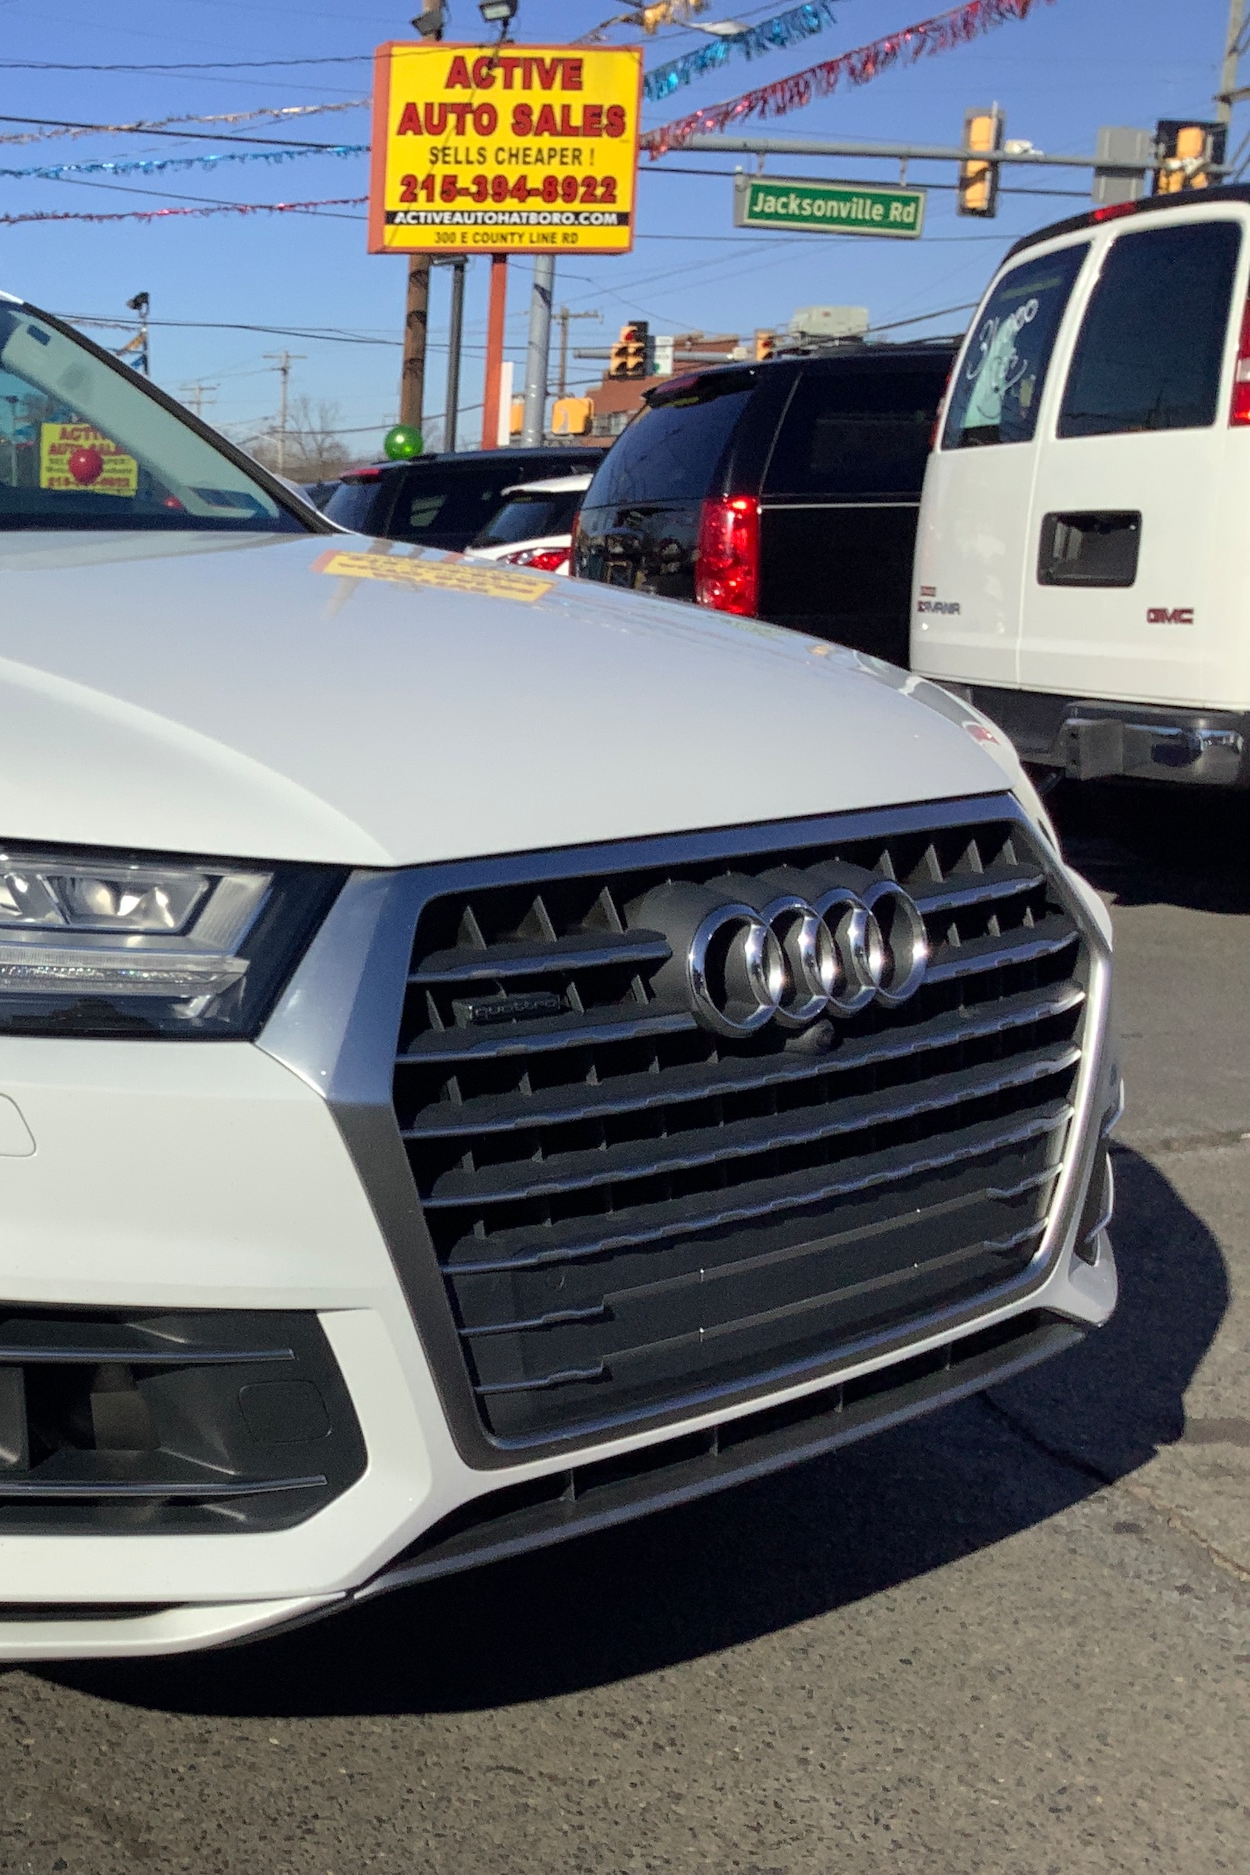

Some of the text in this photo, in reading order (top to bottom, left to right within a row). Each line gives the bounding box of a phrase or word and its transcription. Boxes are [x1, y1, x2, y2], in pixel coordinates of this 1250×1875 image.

[444, 55, 584, 91] ACTIVE
[396, 102, 627, 138] AUTO SALES
[429, 146, 487, 165] SELLS
[495, 147, 583, 166] CHEAPER
[400, 174, 618, 204] 215-394-8922
[394, 212, 618, 225] ACTIVEAUTOHATBORO.COM
[753, 193, 916, 223] Jacksonville Rd
[433, 231, 579, 244] 300 E COUNTY LINE RD
[1147, 608, 1194, 624] GMC
